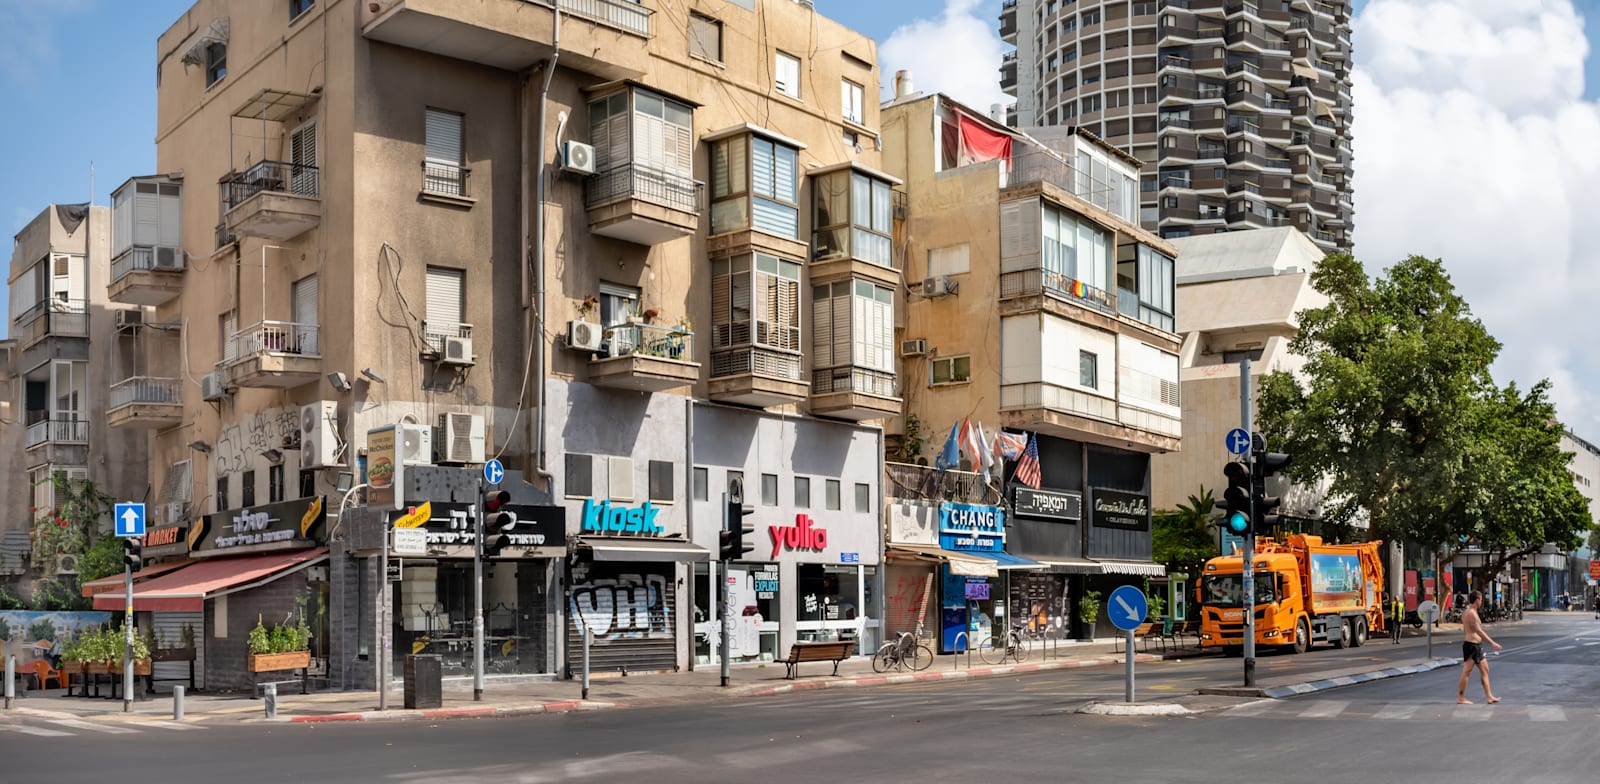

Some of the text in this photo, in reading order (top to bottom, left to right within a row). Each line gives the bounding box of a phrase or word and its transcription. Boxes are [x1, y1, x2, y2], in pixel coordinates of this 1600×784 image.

[148, 526, 179, 546] MARKET
[426, 532, 460, 543] ישראל
[500, 533, 546, 545] שווארמ
[768, 513, 827, 557] yullia
[755, 581, 779, 592] EXPLICIT
